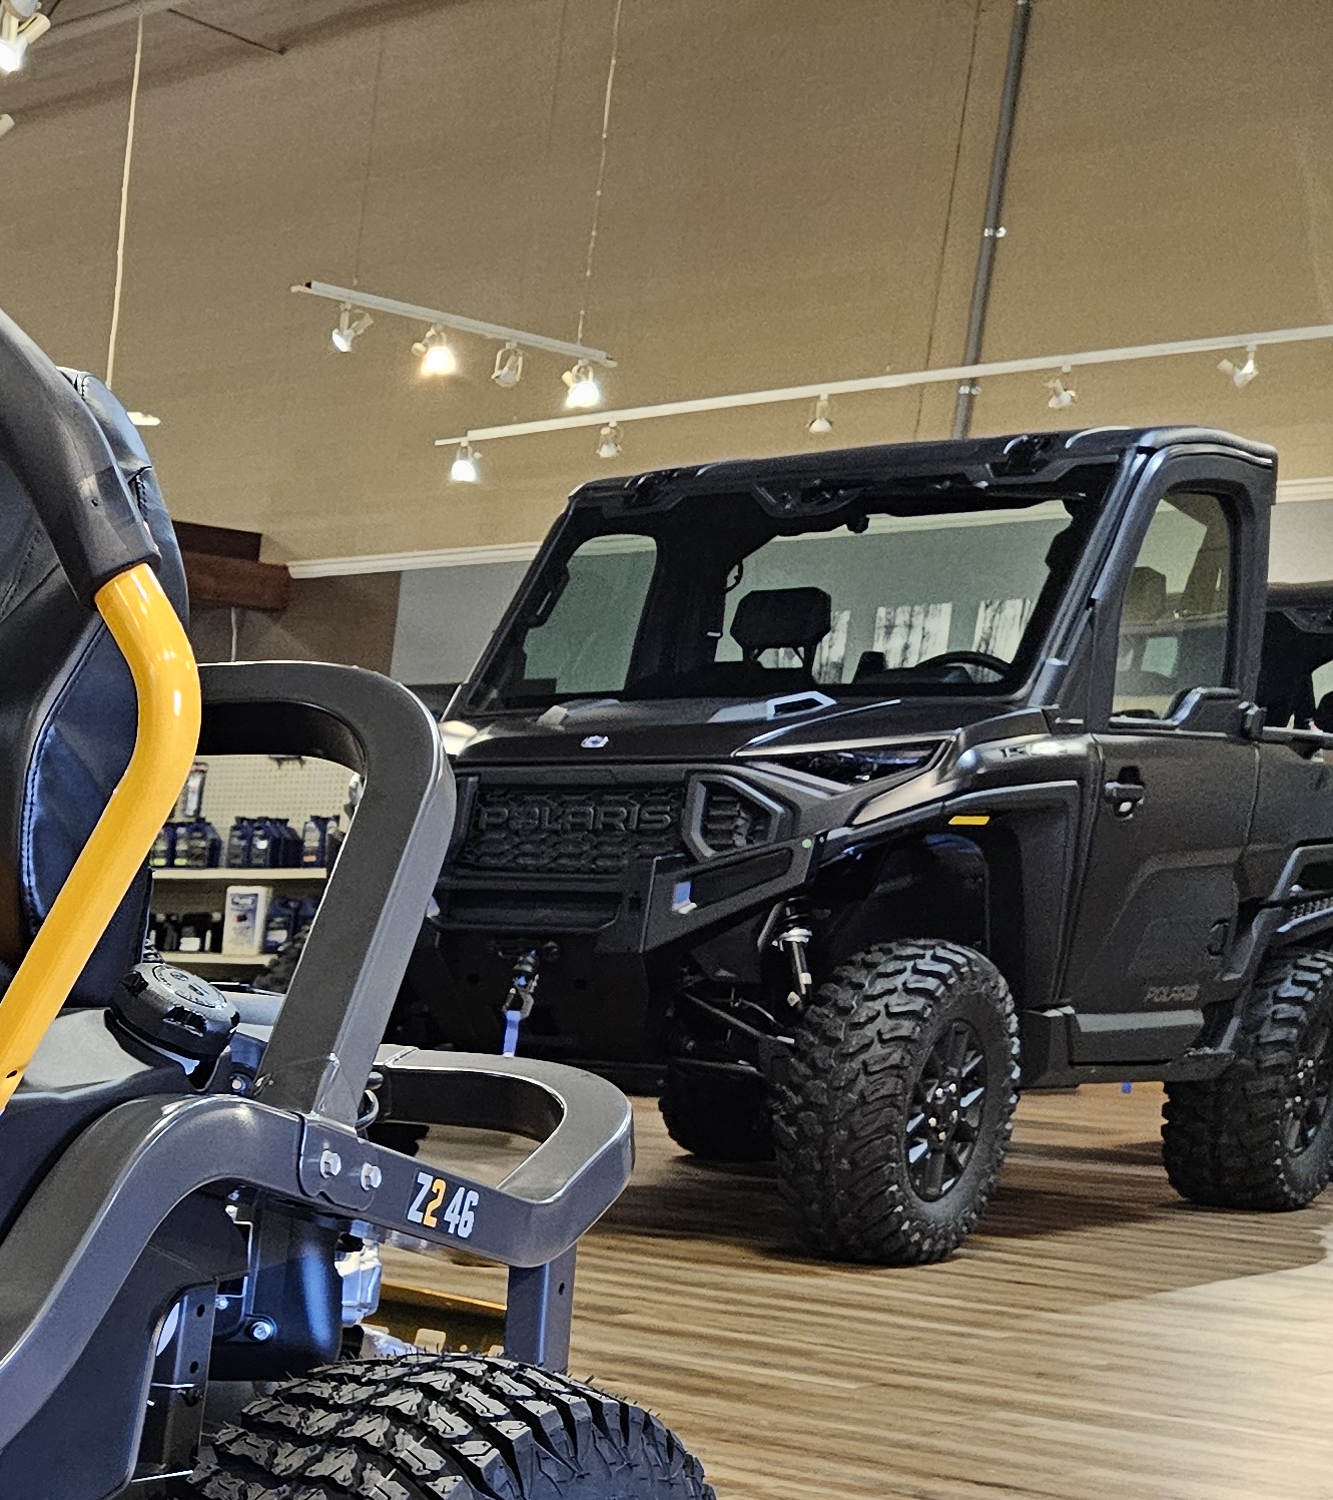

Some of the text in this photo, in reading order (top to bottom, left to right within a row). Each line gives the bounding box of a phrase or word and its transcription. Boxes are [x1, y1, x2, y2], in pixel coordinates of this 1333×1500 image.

[478, 804, 672, 832] POLARIS
[406, 1171, 480, 1239] Z2 46
